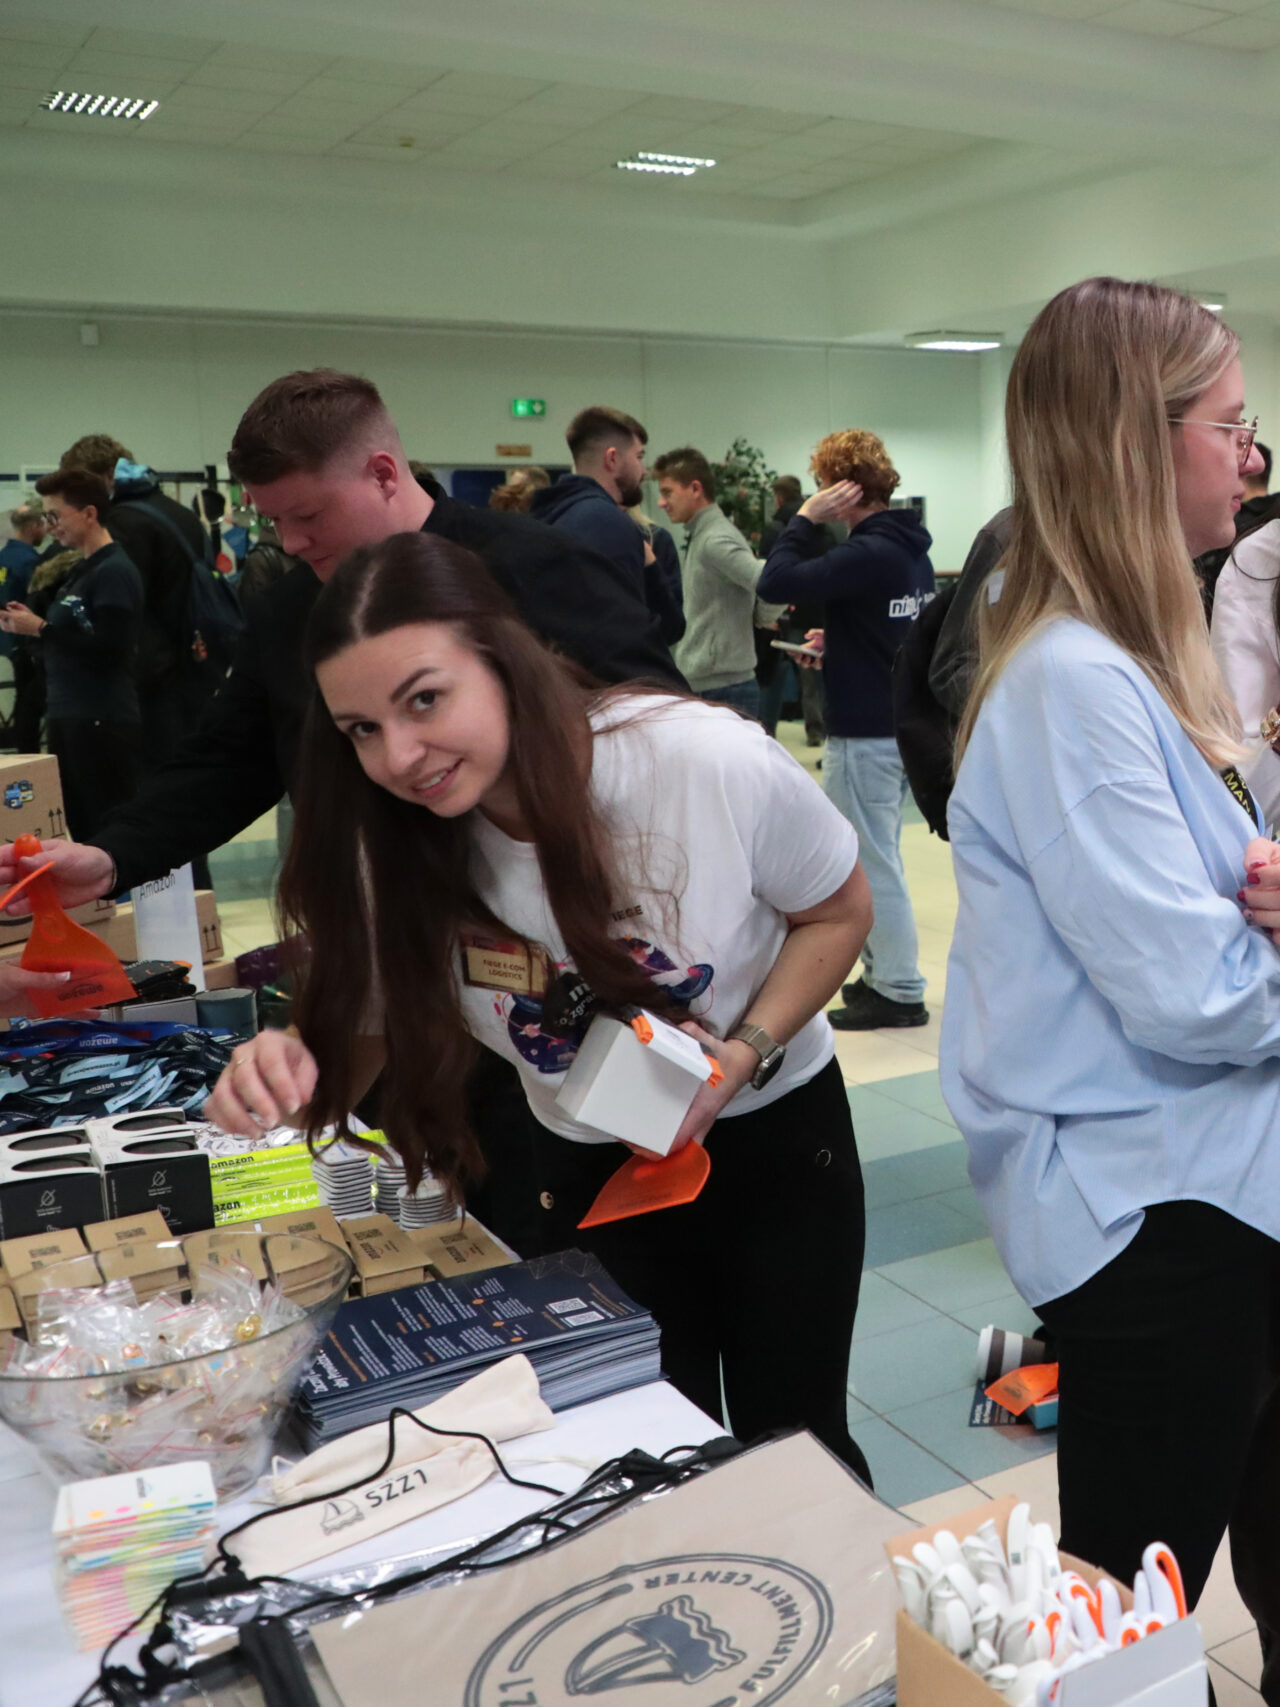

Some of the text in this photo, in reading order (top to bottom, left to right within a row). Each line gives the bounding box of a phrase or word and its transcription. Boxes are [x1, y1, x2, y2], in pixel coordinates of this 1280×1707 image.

[1223, 772, 1251, 814] MAN
[139, 873, 176, 900] Amazon
[612, 905, 643, 922] IEGE
[488, 970, 523, 981] LOGISTICS
[213, 1200, 241, 1213] azon
[643, 1569, 801, 1694] FULFILLMENT CENTER
